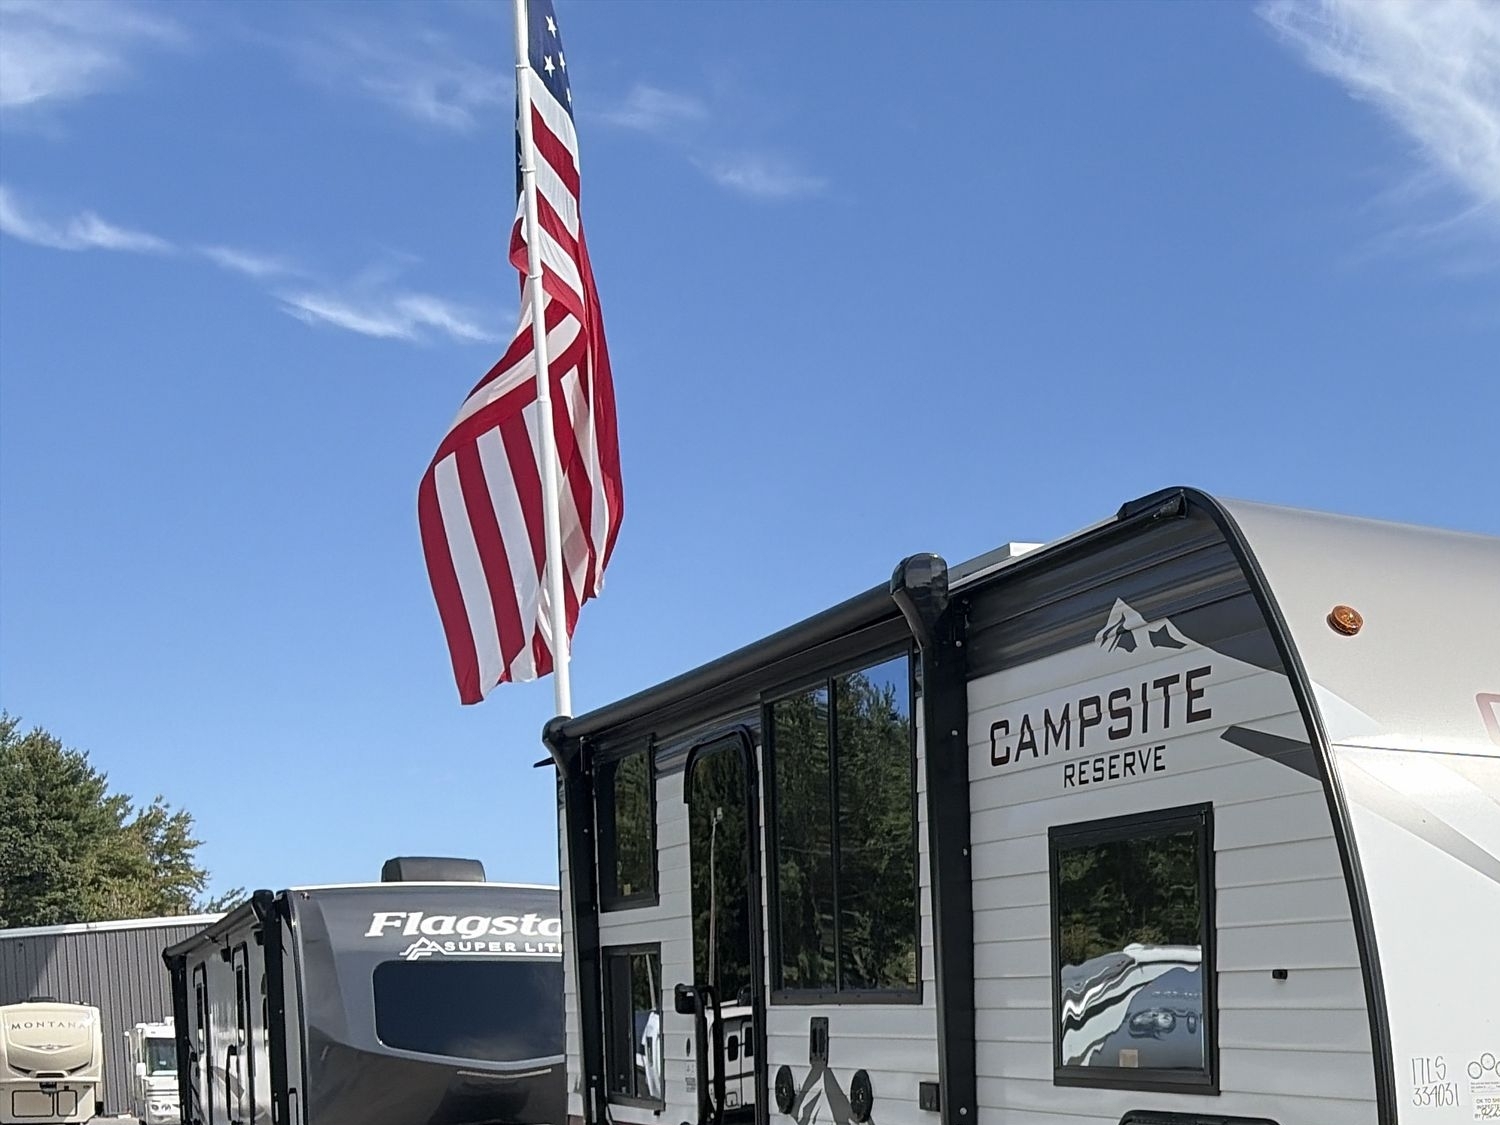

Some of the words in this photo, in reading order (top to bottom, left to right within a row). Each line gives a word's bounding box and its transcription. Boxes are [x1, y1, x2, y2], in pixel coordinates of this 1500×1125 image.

[990, 665, 1212, 767] CAMPSITE
[1063, 744, 1166, 788] RESERVE
[444, 941, 517, 952] SUPER
[11, 1021, 86, 1031] MONTANA
